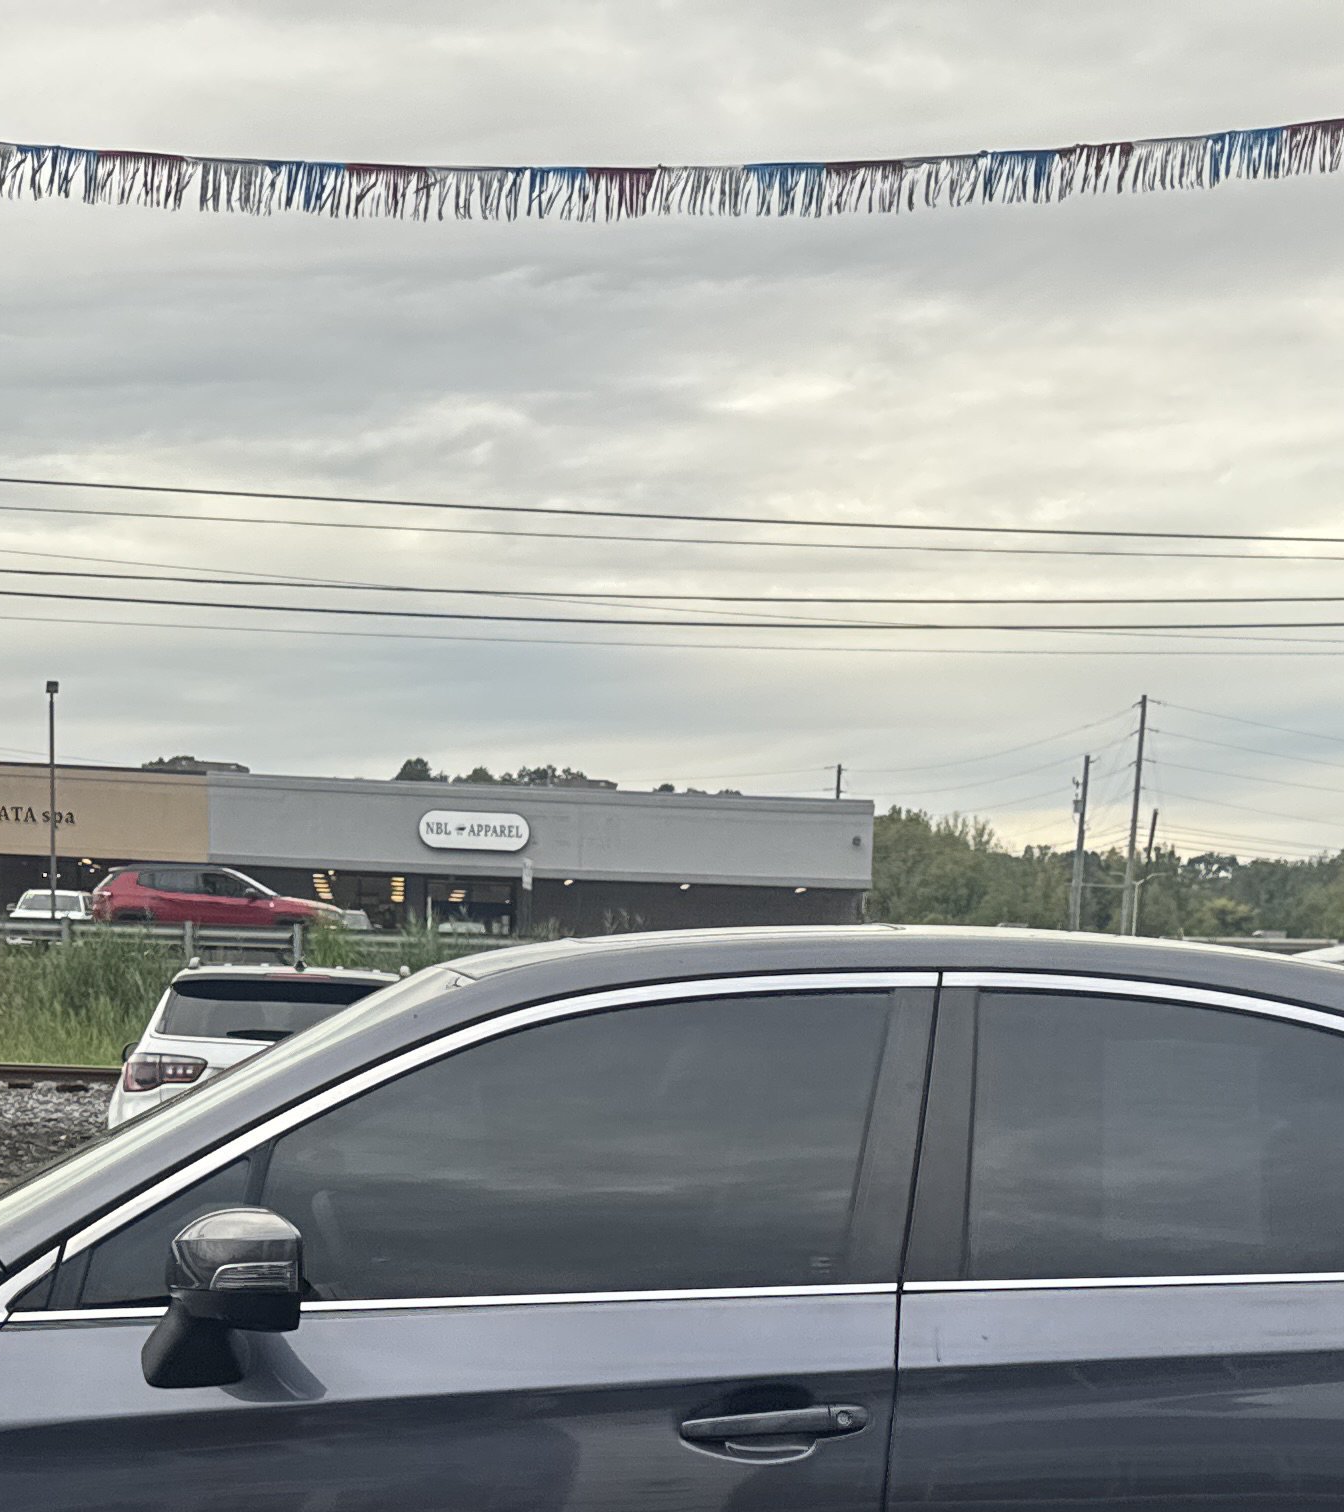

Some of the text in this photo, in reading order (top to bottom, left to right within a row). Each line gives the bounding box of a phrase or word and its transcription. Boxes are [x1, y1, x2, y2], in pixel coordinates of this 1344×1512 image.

[42, 810, 75, 829] spa
[425, 821, 523, 839] NBL APPAREL
